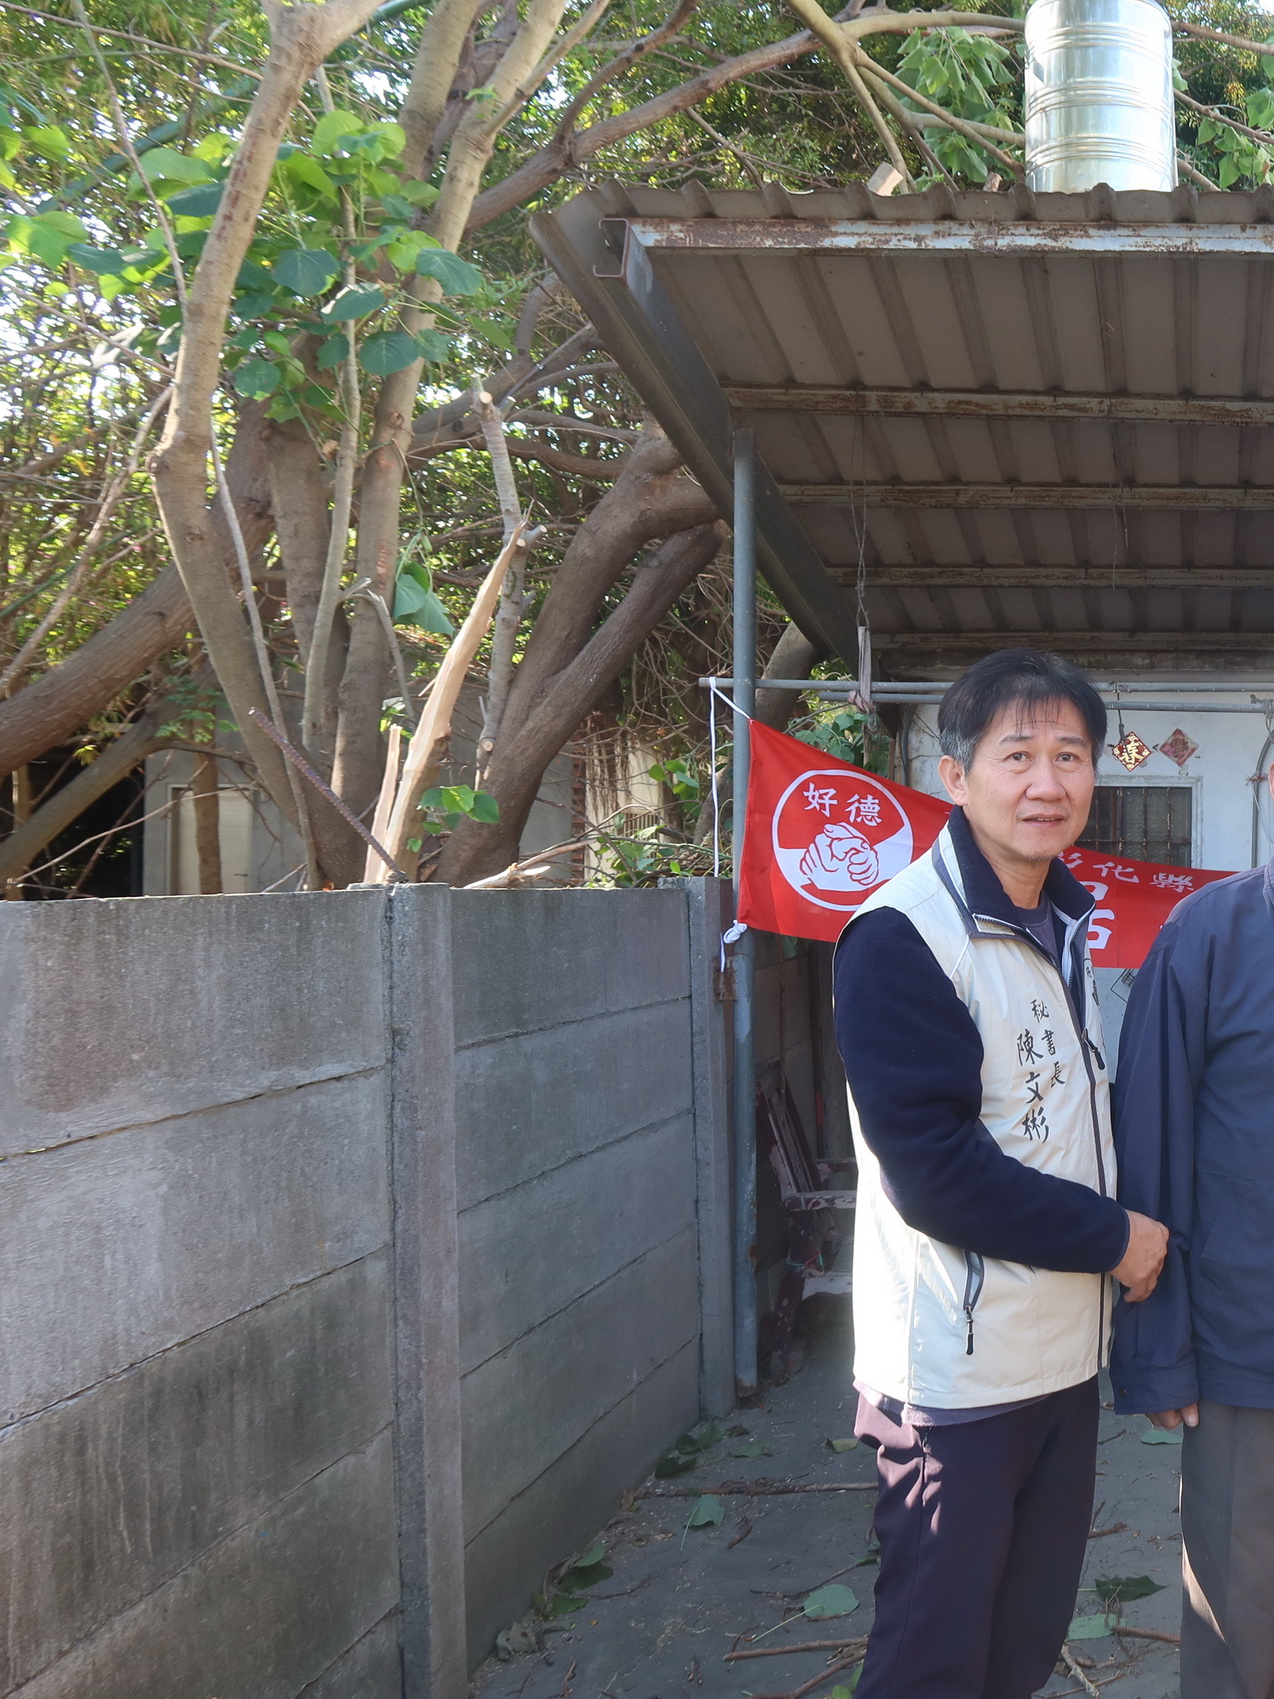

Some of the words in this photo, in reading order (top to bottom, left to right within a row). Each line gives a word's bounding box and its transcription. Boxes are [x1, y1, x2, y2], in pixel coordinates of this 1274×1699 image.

[803, 782, 883, 828] 好德
[1016, 1028, 1050, 1144] 陳文彬
[1030, 999, 1066, 1089] 秘書長
